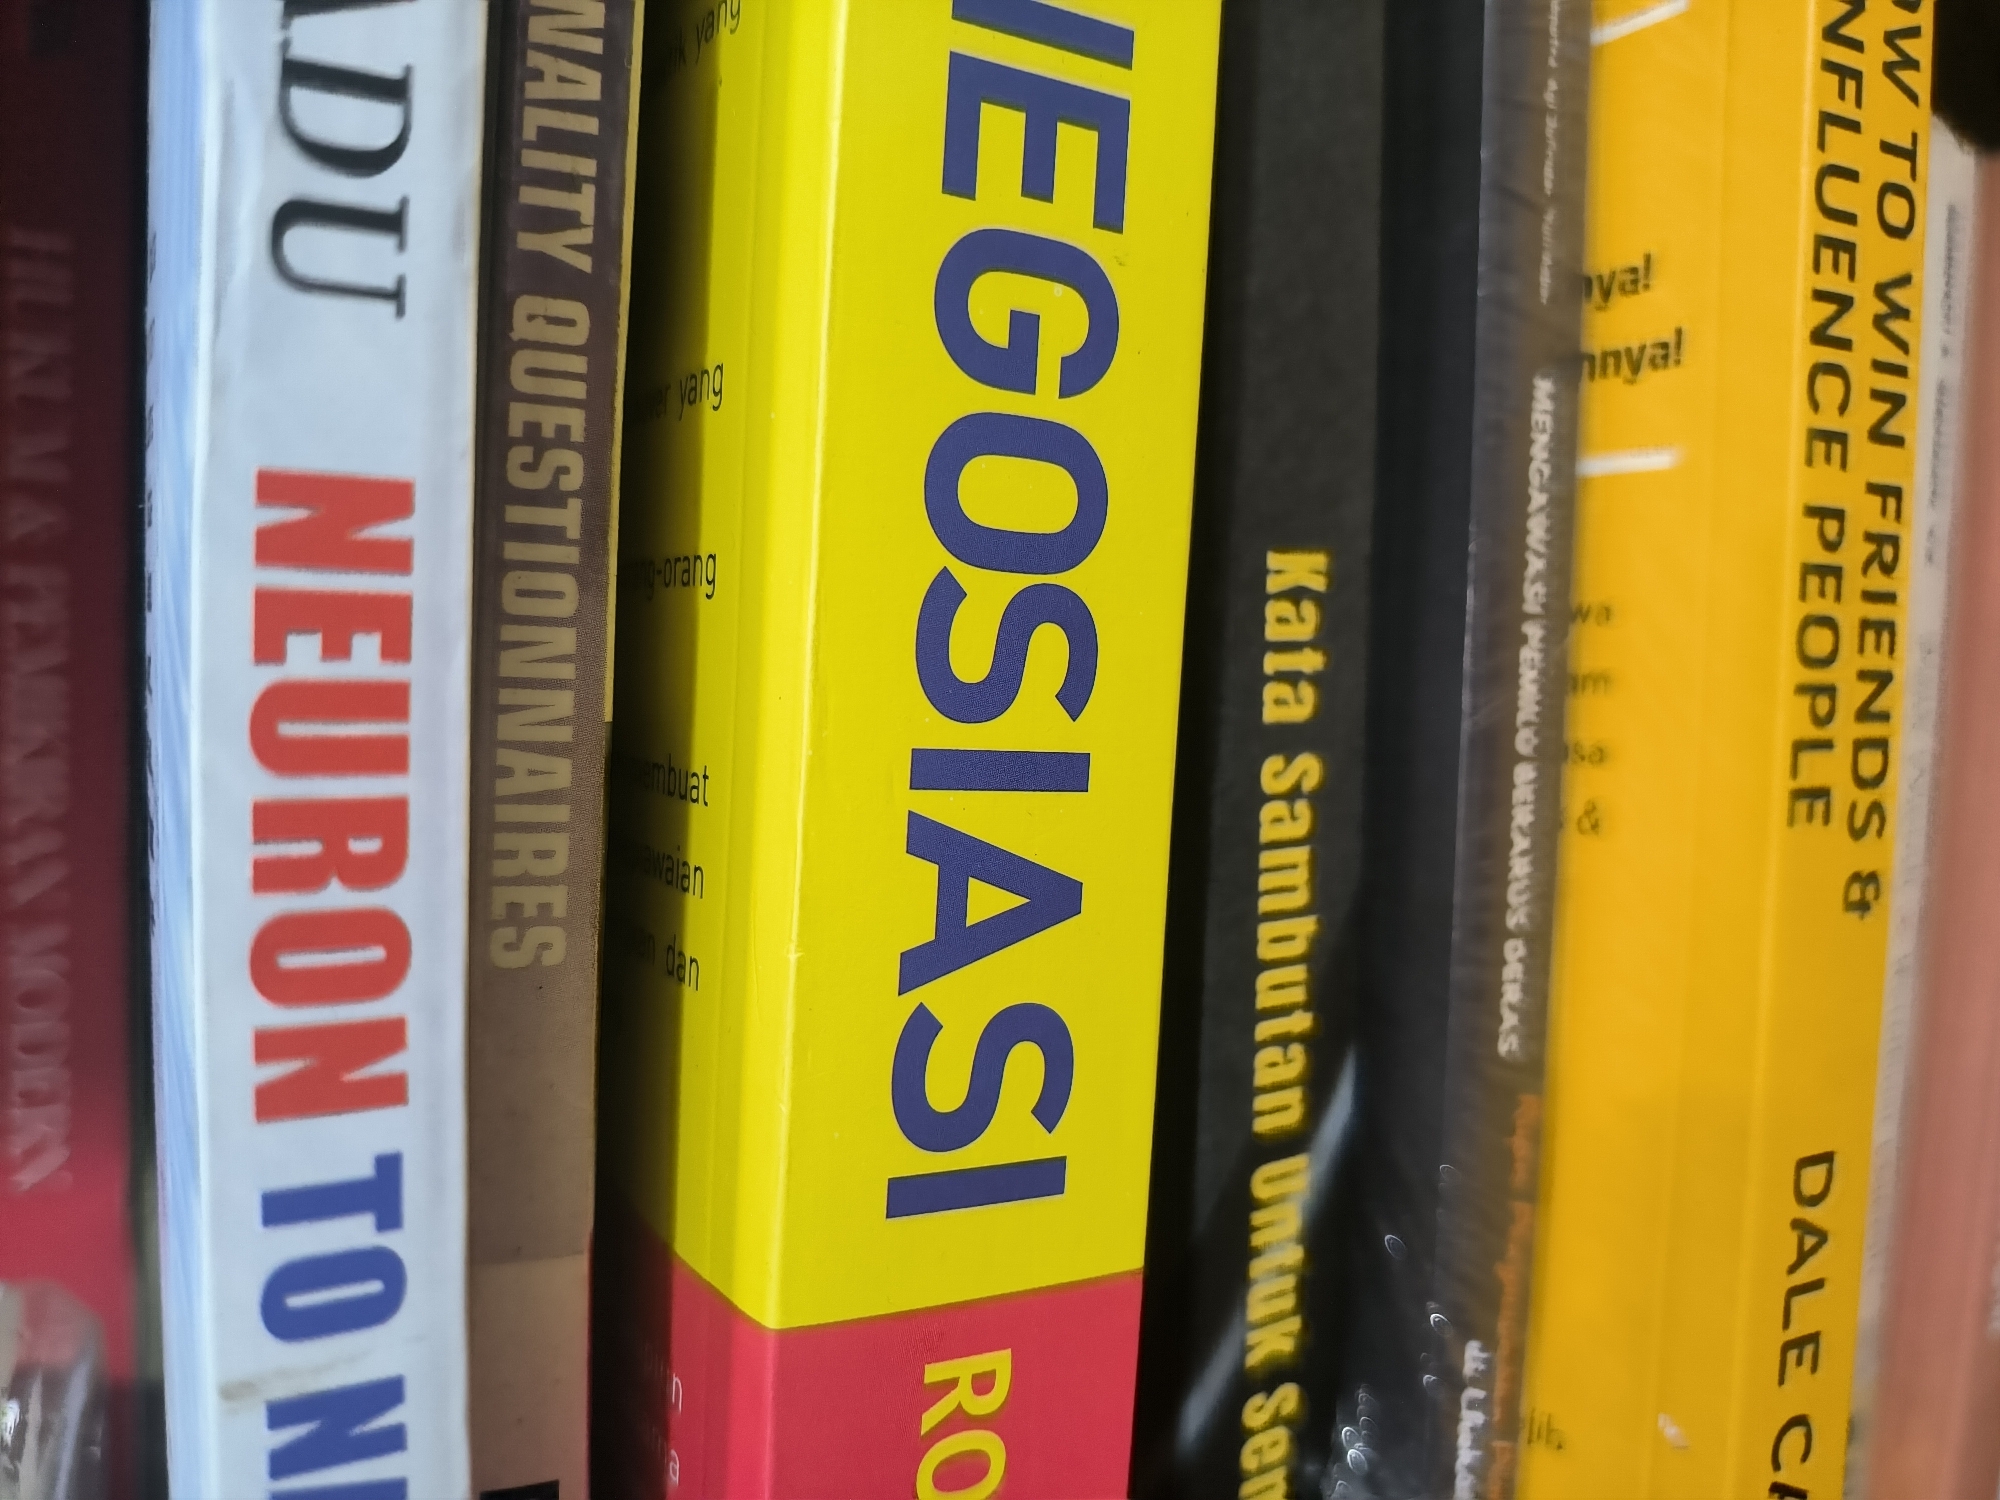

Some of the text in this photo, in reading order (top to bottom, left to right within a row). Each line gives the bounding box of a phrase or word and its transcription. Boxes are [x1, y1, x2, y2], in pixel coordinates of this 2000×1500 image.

[271, 0, 414, 320] DU
[1876, 131, 1918, 241] TO
[679, 363, 724, 421] yang
[1867, 272, 1913, 450] WIN
[489, 294, 592, 971] QUESTIONNAIRES
[1261, 548, 1331, 727] Kata
[1787, 503, 1846, 829] PEOPLE
[1846, 480, 1904, 842] FRIENDS
[249, 467, 416, 1500] NEURON TO N
[666, 934, 700, 992] dan
[1251, 753, 1323, 1136] Sambutan
[1844, 869, 1881, 919] &
[1245, 1152, 1310, 1370] Untuk
[1778, 1150, 1836, 1388] DALE
